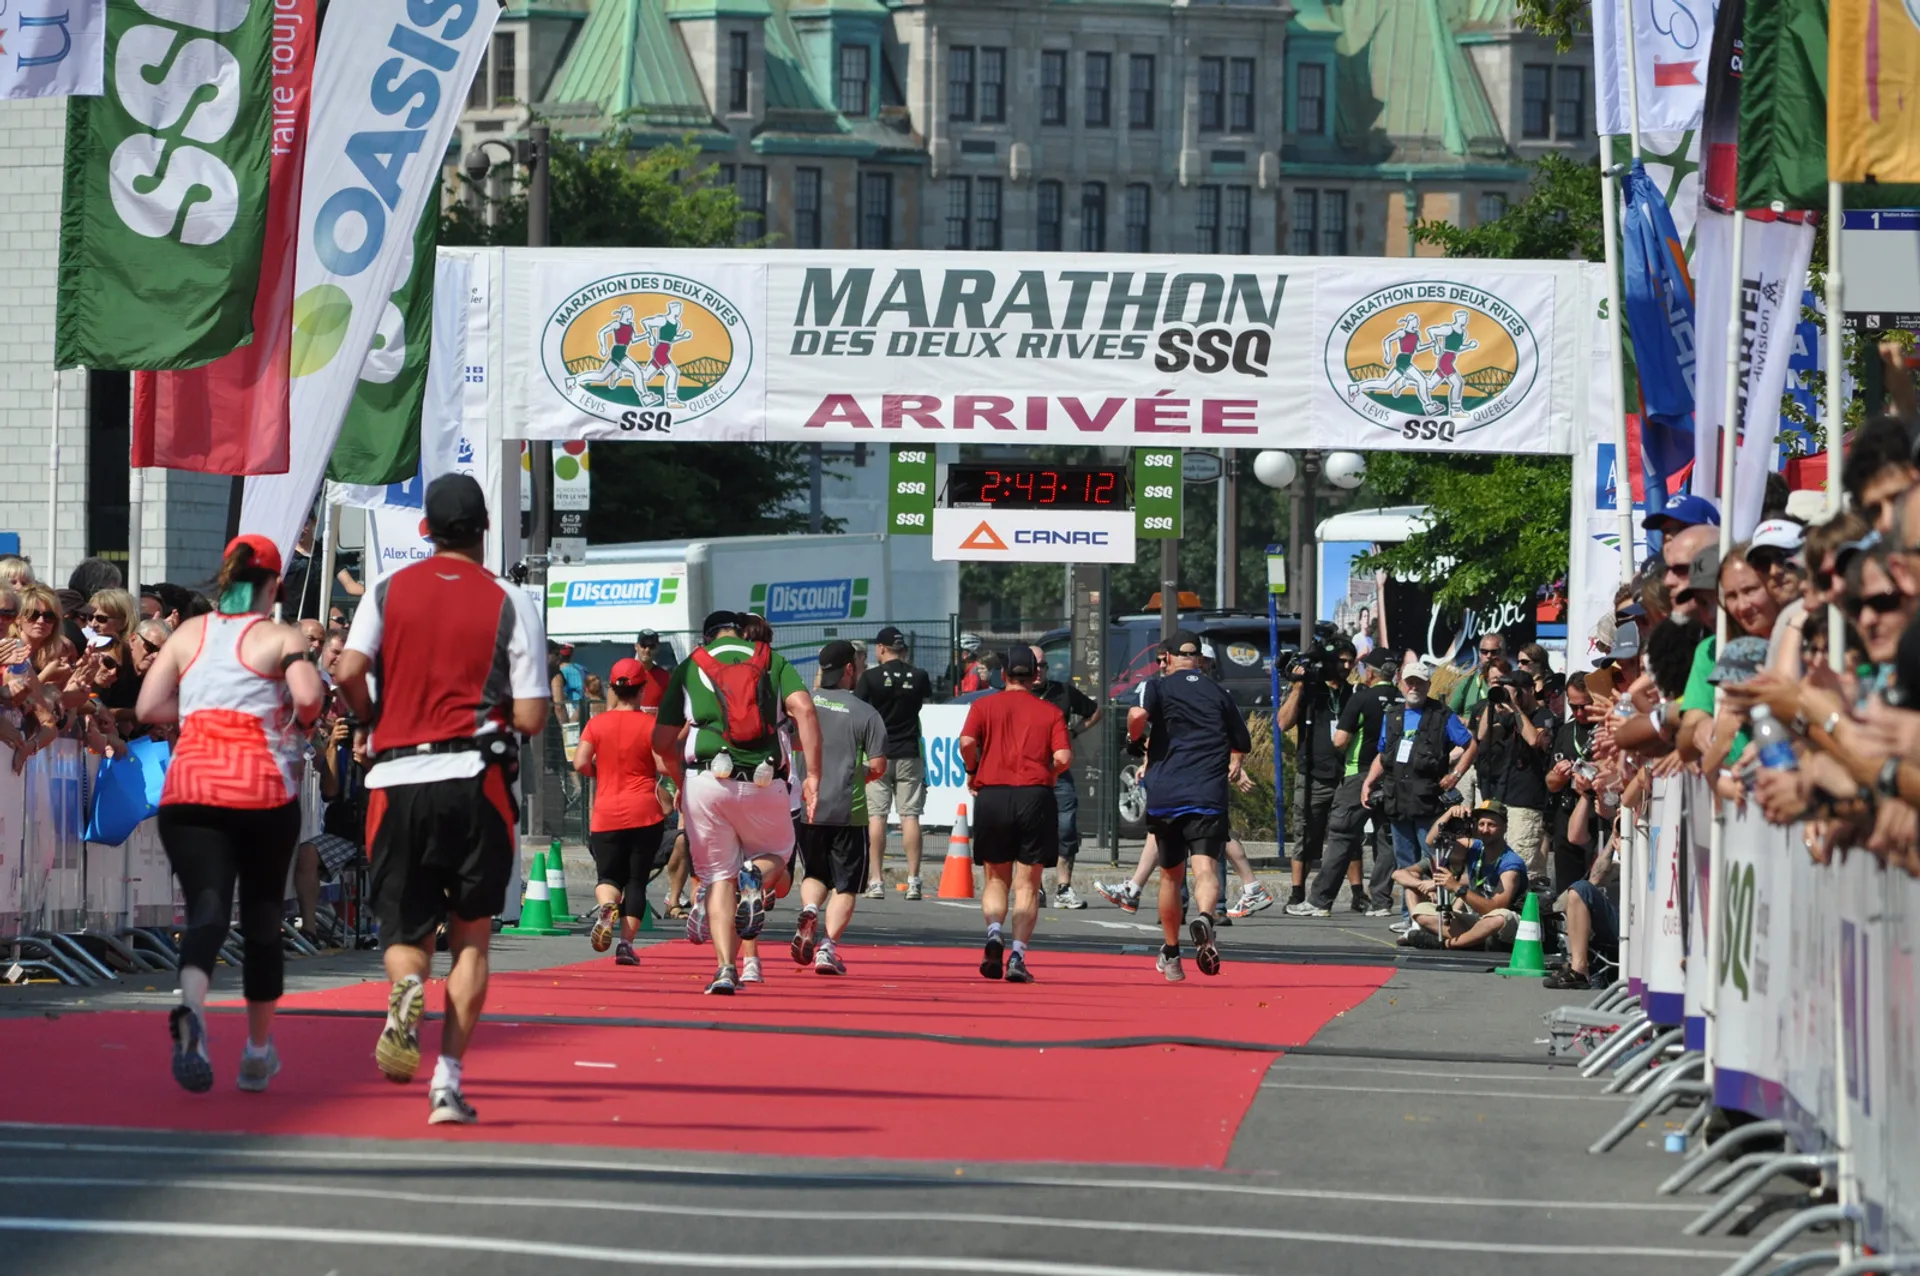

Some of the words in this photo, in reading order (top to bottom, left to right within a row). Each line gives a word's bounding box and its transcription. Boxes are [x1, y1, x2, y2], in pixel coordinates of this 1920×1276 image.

[109, 0, 251, 246] SS
[314, 0, 480, 277] OASIS
[555, 278, 627, 327] MARATHON
[631, 277, 659, 290] DES
[663, 278, 703, 299] DEUX
[701, 293, 739, 327] RIVES
[793, 266, 1289, 331] MARATHON
[1340, 286, 1414, 334] MARATHON
[1417, 286, 1445, 298] DES
[1449, 287, 1490, 309] DEUX
[1489, 302, 1525, 337] RIVES
[790, 330, 877, 357] DES
[886, 331, 1006, 358] DEUX
[1015, 332, 1148, 360] RIVES
[1154, 326, 1272, 378] SSQ
[579, 393, 607, 413] LÉVIS
[688, 385, 729, 412] QUÉBEC
[1473, 394, 1514, 422] QUÉBEC
[620, 411, 672, 434] SSQ
[803, 389, 1259, 435] ARRIVÉE
[1362, 403, 1391, 422] LÉVIS
[1402, 419, 1456, 442] SSQ
[898, 451, 927, 464] SSQ
[1144, 454, 1173, 468] SSQ
[897, 482, 926, 495] SSQ
[1144, 485, 1173, 499] SSQ
[896, 513, 925, 527] SSQ
[1143, 516, 1173, 530] SSQ
[1014, 530, 1109, 545] CANAC
[383, 547, 408, 560] Alex
[410, 547, 434, 560] Coul
[572, 580, 655, 601] Discount
[771, 581, 847, 612] Discount
[922, 736, 966, 788] SIS
[1720, 860, 1755, 1003] SQ
